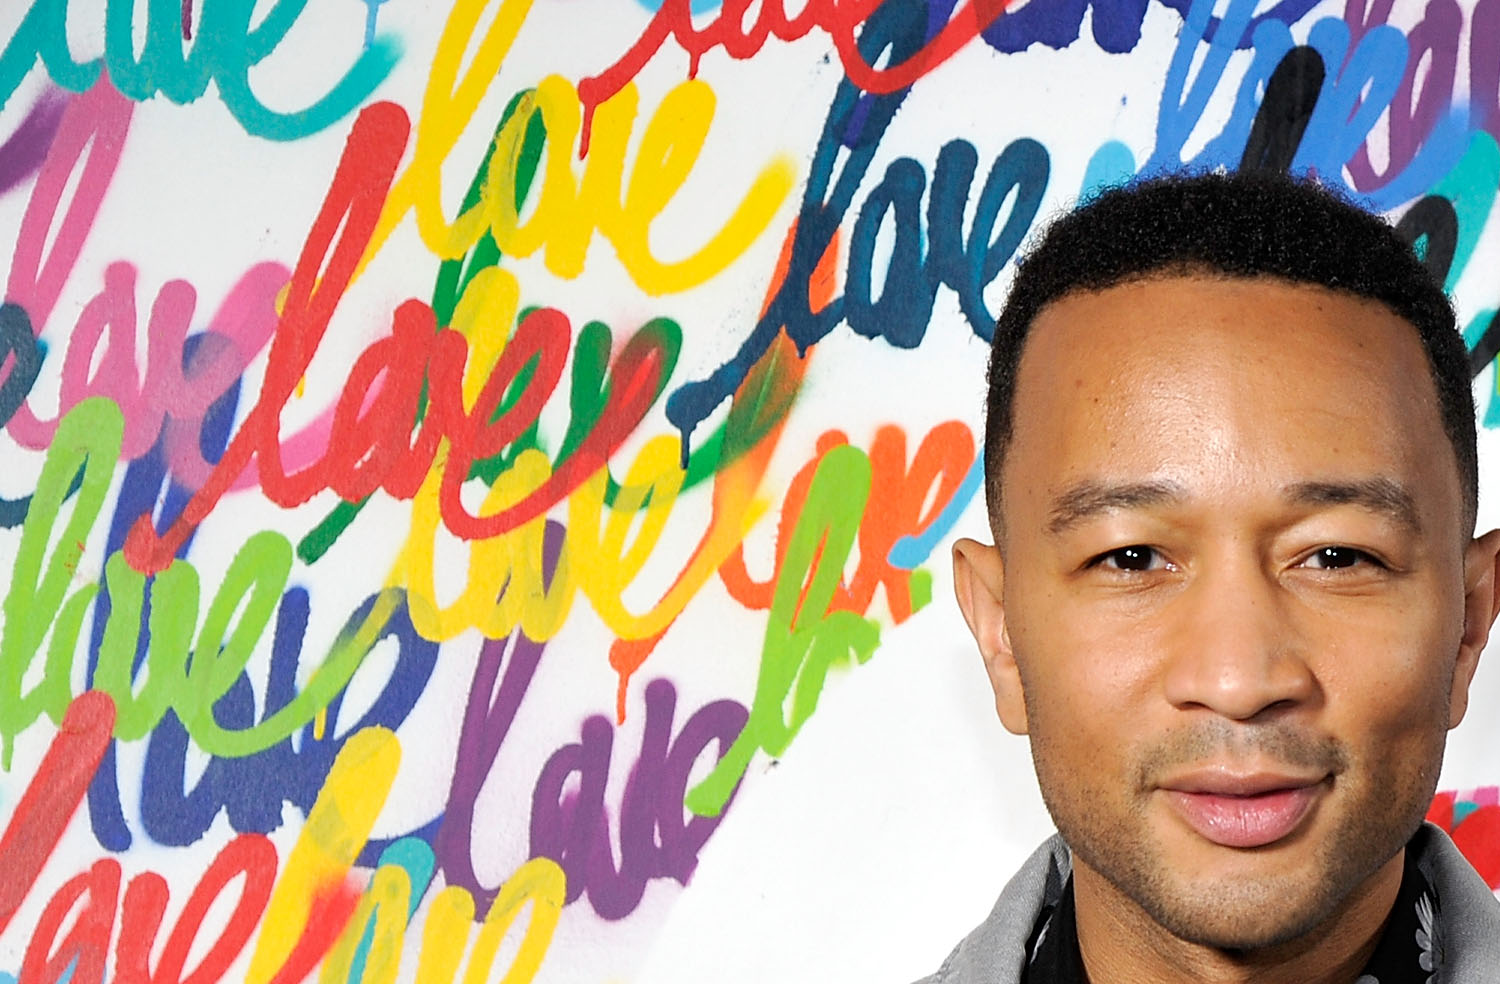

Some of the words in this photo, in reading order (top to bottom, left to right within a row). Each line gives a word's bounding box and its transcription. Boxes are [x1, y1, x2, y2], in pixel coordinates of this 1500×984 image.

[122, 100, 664, 575] love
[275, 0, 797, 297] love
[665, 0, 1052, 470] love
[0, 397, 408, 758] love
[305, 265, 770, 643] love
